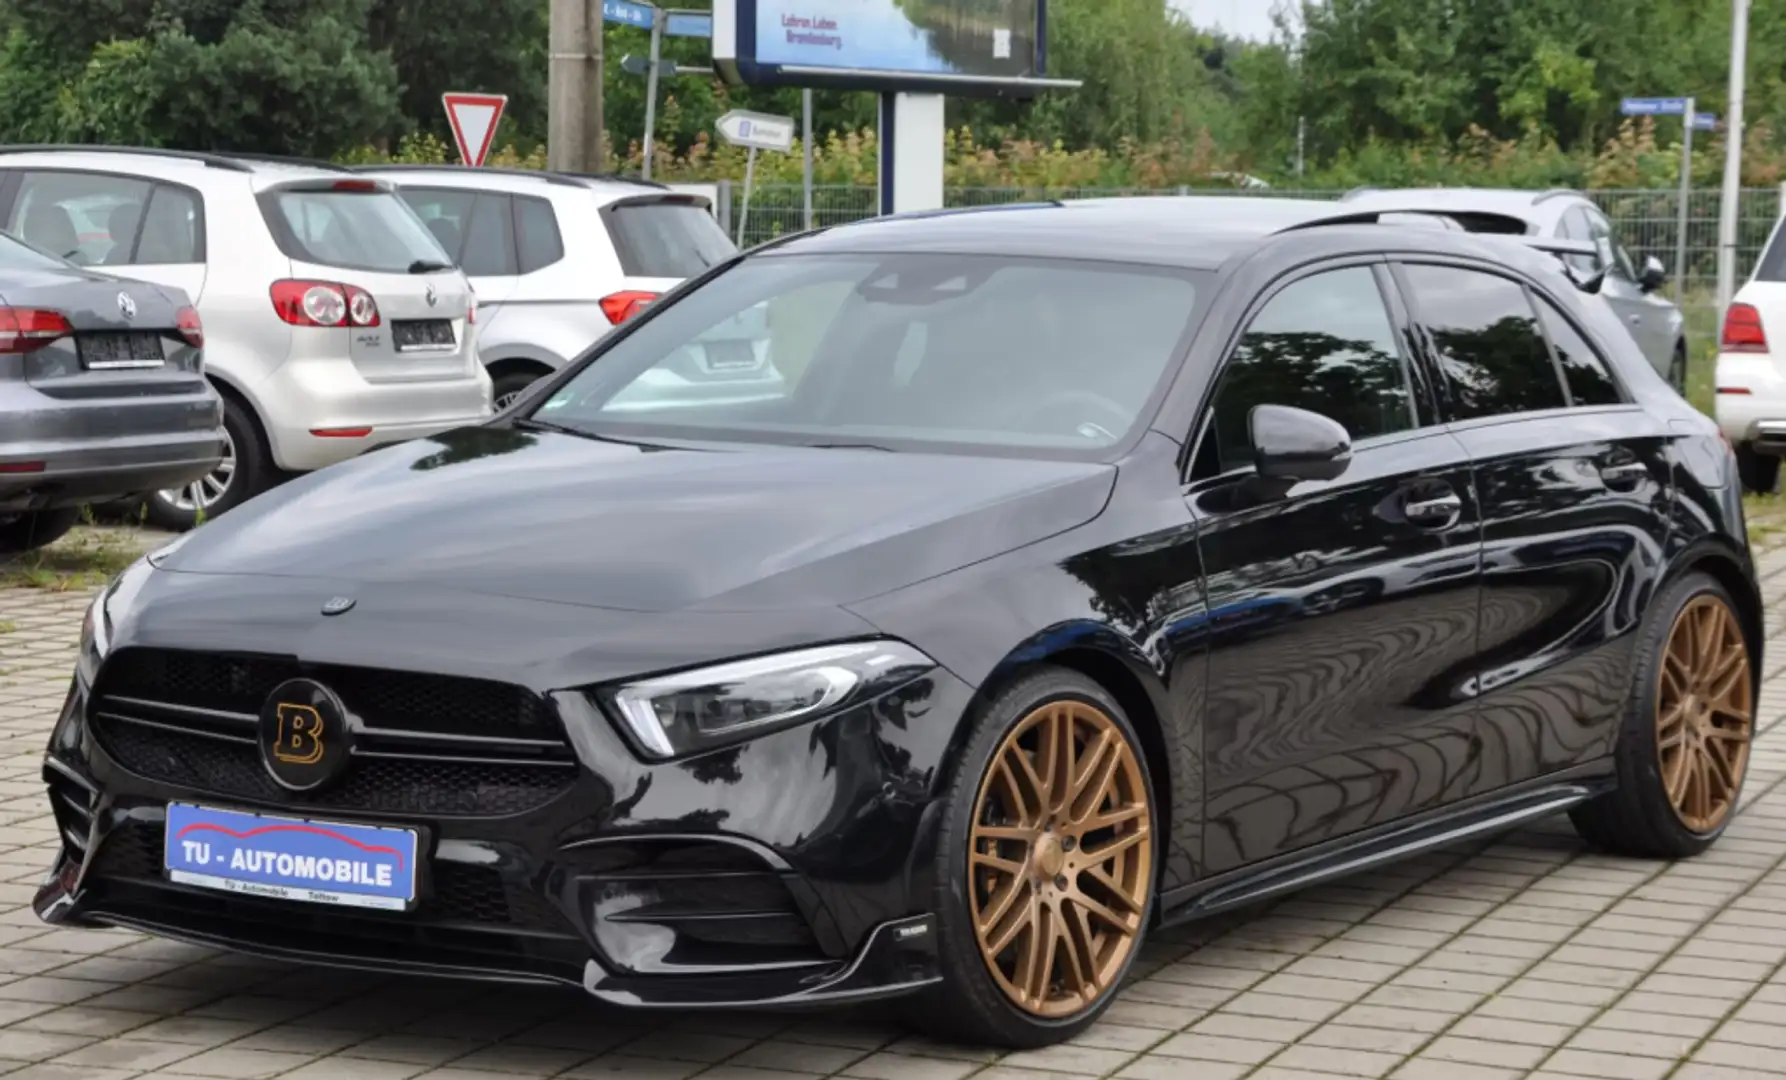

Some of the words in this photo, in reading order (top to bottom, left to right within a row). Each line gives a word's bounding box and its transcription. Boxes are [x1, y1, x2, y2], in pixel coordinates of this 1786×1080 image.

[273, 702, 324, 764] B
[182, 840, 210, 865] TU
[230, 848, 393, 887] AUTOMOBILE
